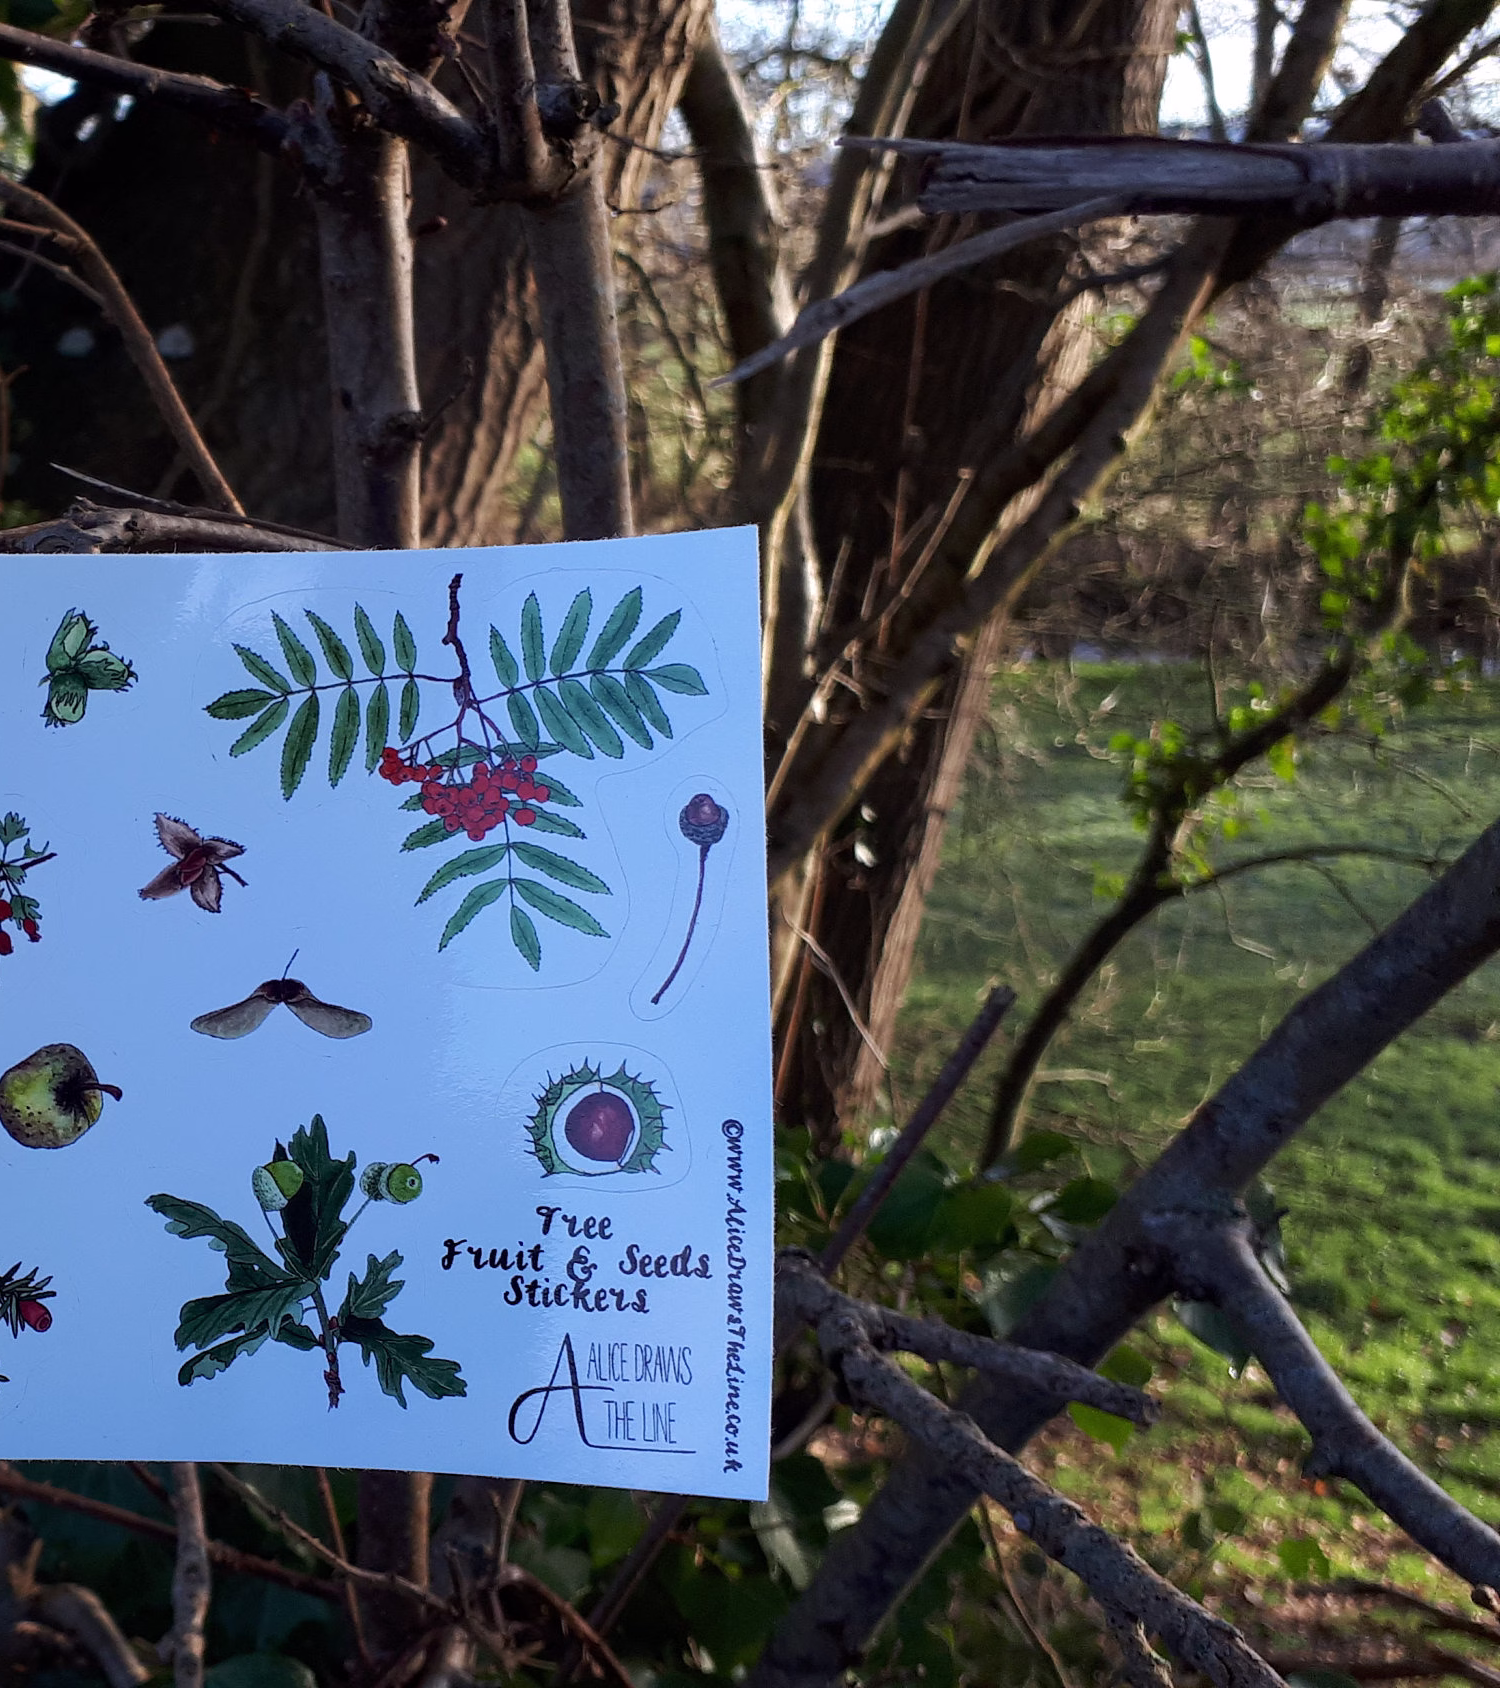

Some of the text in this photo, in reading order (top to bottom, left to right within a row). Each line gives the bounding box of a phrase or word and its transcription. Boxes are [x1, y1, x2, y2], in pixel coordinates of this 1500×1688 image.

[535, 1205, 614, 1240] Tree
[441, 1238, 713, 1282] Fruit & Seeds
[503, 1274, 650, 1314] Stickers
[587, 1342, 693, 1386] ALICE DRAWS
[604, 1400, 677, 1444] THE LINE
